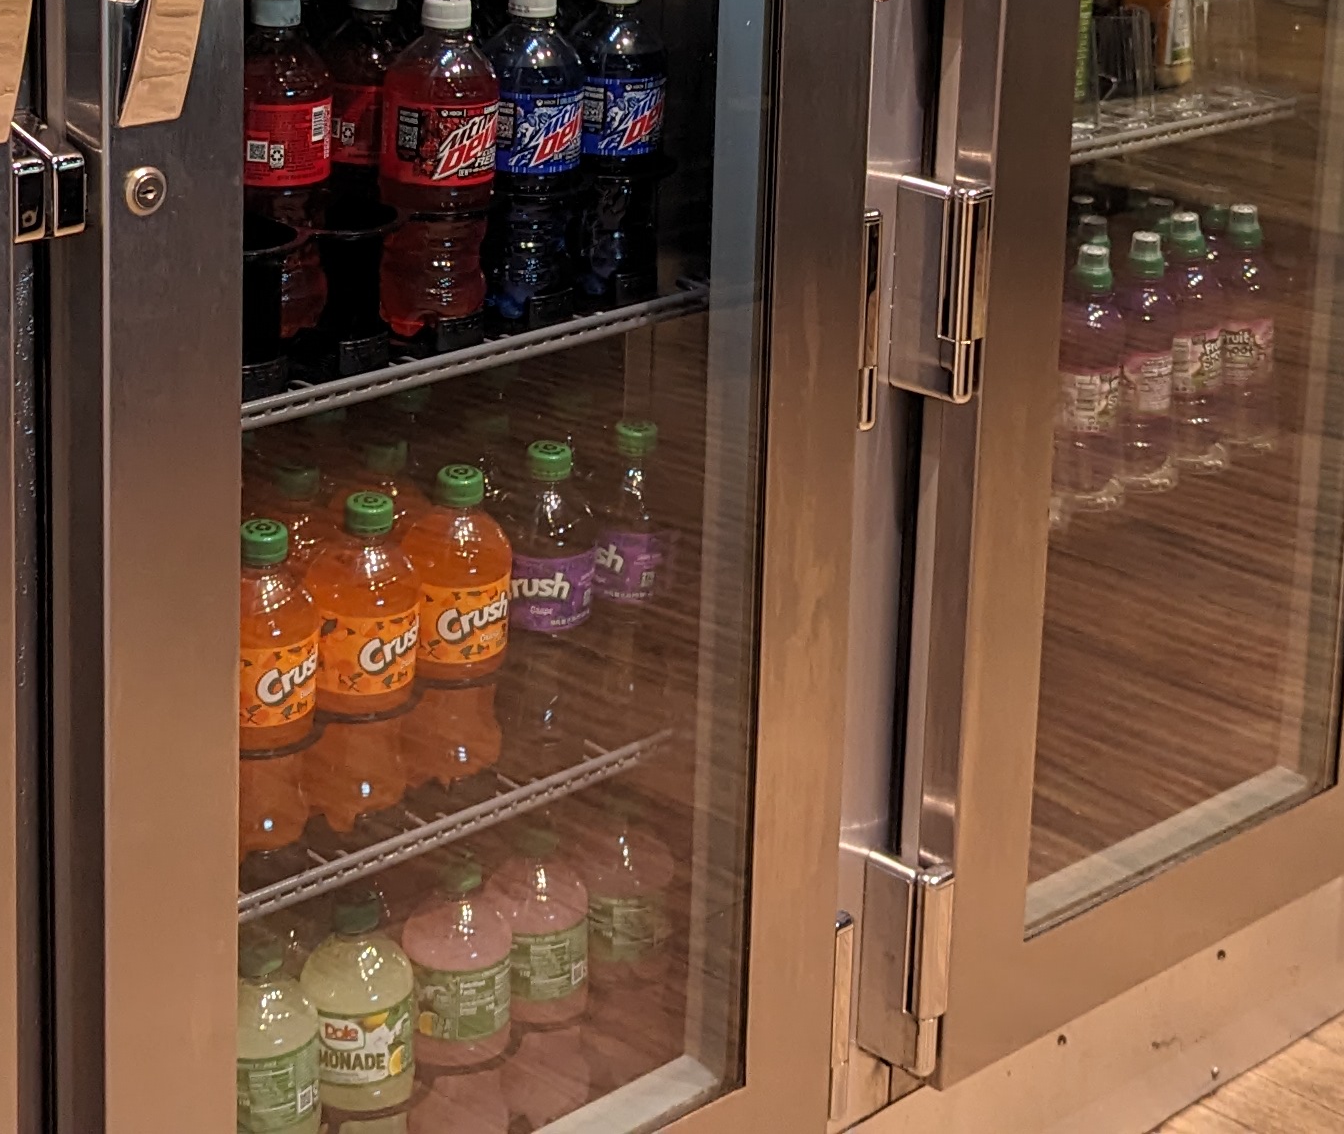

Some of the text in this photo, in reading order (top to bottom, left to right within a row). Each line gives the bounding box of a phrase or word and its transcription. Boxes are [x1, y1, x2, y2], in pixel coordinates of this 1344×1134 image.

[511, 572, 571, 600] rush
[437, 590, 508, 641] Crush
[319, 1049, 386, 1071] MONADE
